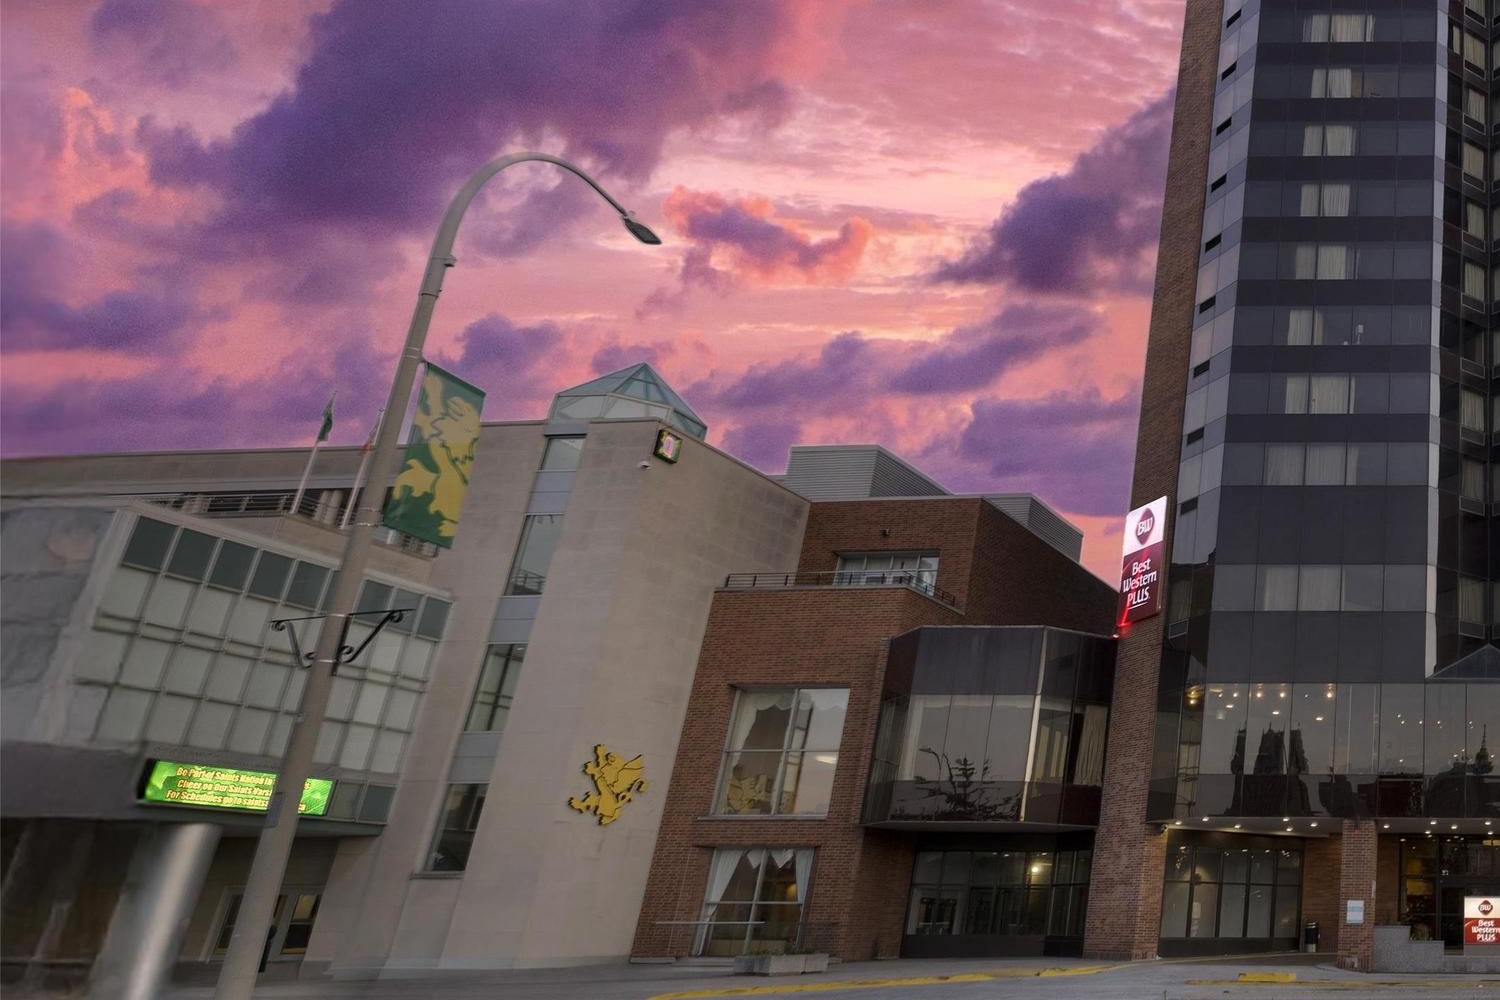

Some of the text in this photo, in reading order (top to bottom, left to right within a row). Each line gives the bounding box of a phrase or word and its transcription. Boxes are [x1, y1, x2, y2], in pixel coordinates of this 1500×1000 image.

[1137, 517, 1153, 536] BW
[1132, 558, 1151, 576] Best
[1123, 571, 1157, 593] Western
[1127, 586, 1150, 605] PLUS
[1471, 926, 1500, 934] Western
[1478, 919, 1495, 927] Best
[1476, 933, 1497, 942] PLUS
